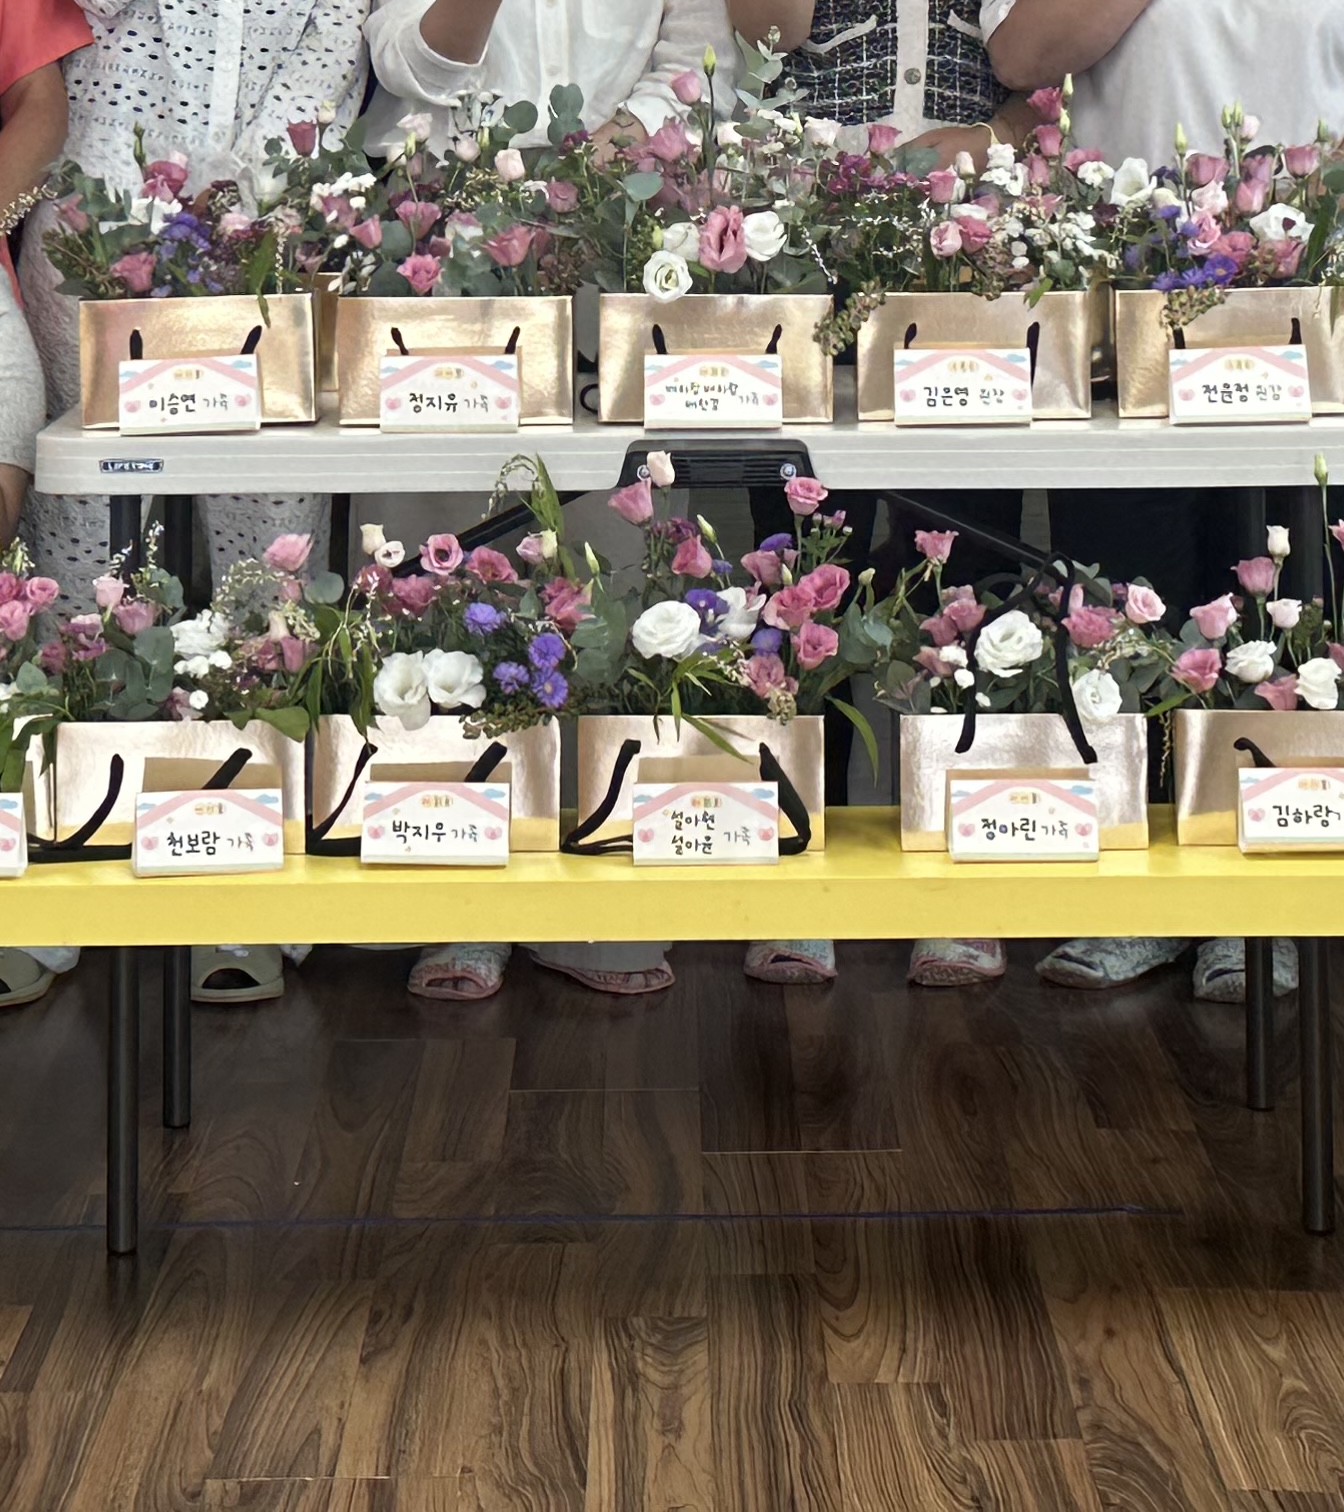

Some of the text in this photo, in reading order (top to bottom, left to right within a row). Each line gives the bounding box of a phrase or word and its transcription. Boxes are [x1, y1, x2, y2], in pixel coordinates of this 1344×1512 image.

[149, 393, 196, 415] 이승연
[409, 393, 458, 413] 정지유
[923, 386, 969, 407] 김은영
[1272, 804, 1332, 828] 김하랑
[392, 820, 446, 844] 박지우
[981, 818, 1036, 841] 정아린
